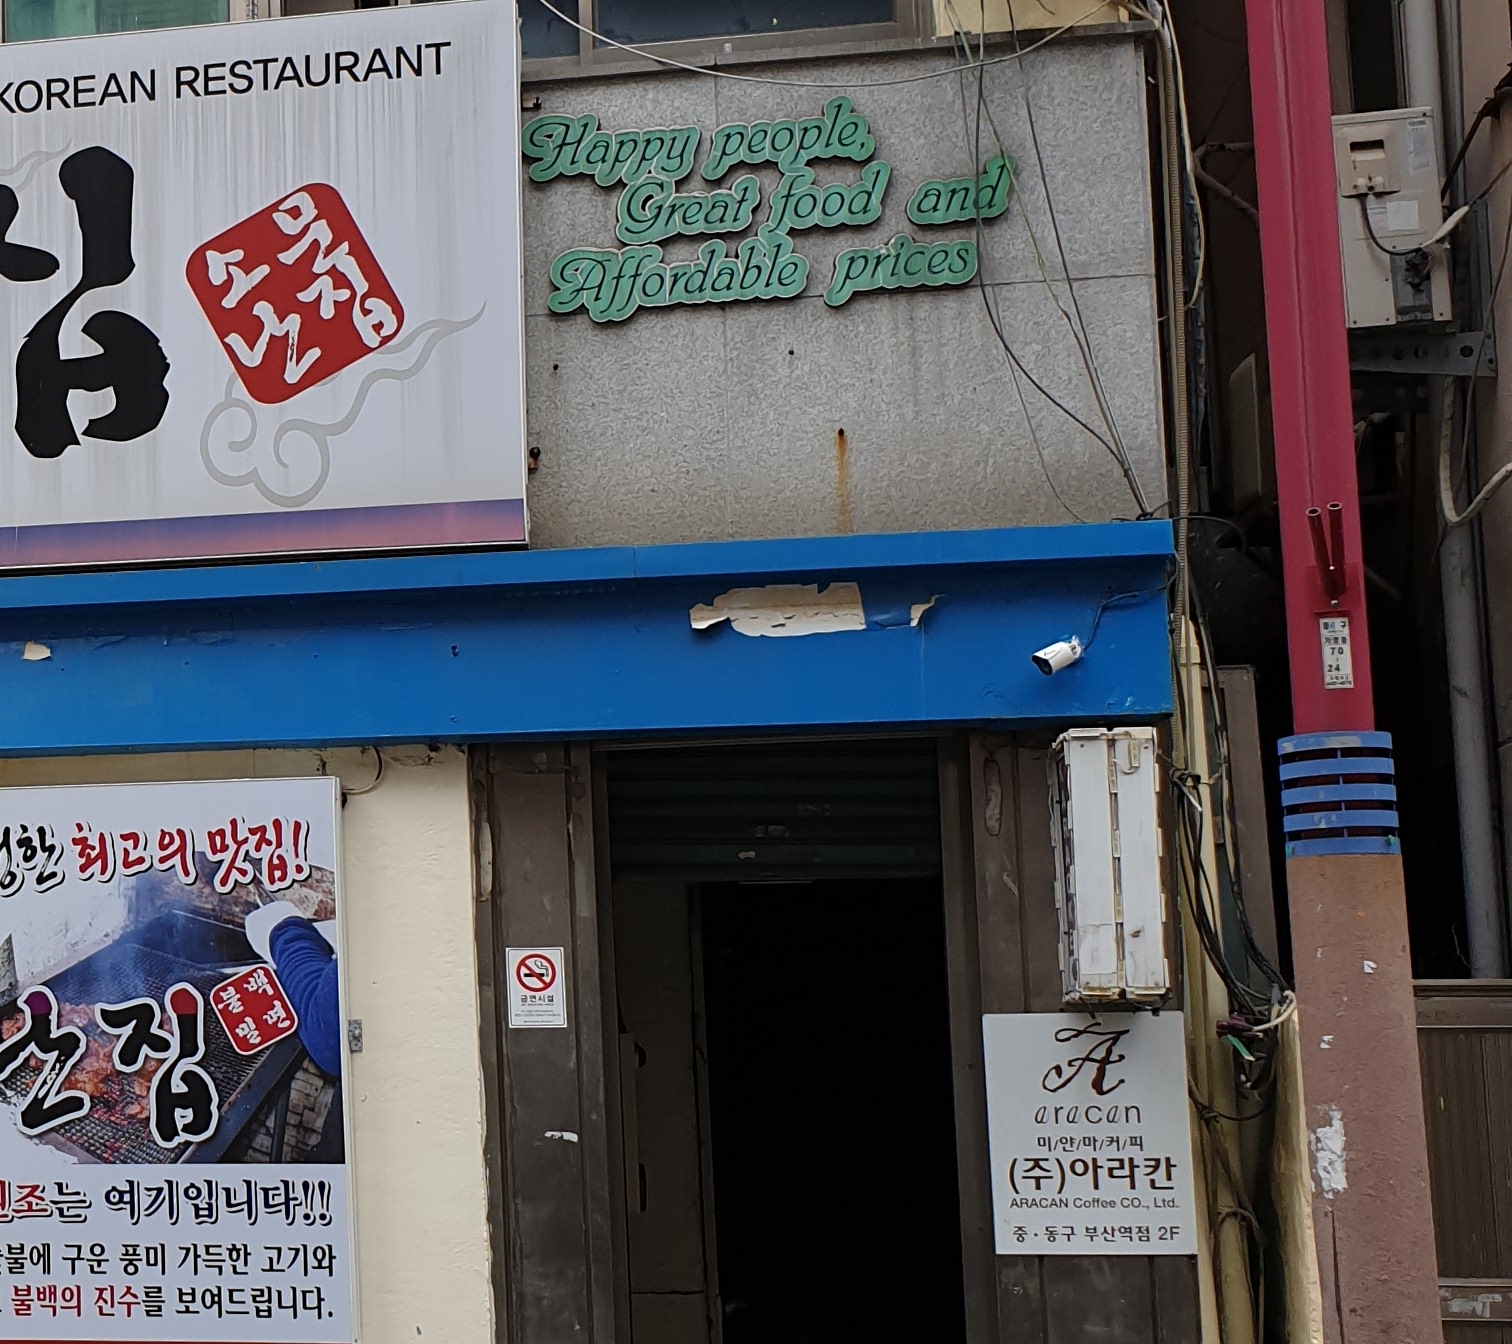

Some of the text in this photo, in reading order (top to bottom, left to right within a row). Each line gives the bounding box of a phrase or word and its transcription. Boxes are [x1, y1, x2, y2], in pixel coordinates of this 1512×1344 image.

[174, 41, 452, 99] RESTAURANT
[529, 101, 868, 178] Happy people,
[624, 158, 1007, 236] Great food and
[558, 234, 970, 315] Affordable prices
[74, 821, 201, 890] 최고의
[206, 815, 314, 894] 맛집!
[1034, 1105, 1142, 1124] aracan
[1008, 1157, 1177, 1194] (주)아라칸
[104, 1178, 333, 1225] 여기입니다!!
[1009, 1197, 1069, 1209] ARACAN
[1072, 1197, 1117, 1209] Coffee
[1153, 1197, 1180, 1209] Ltd.
[1084, 1225, 1151, 1243] 부산역점
[1157, 1226, 1181, 1242] 2F
[61, 1242, 111, 1275] 구운
[119, 1242, 167, 1275] 풍미
[177, 1242, 252, 1275] 가득한
[260, 1242, 337, 1275] 고기와
[11, 1285, 83, 1318] 불백의
[93, 1285, 166, 1318] 진수를
[176, 1285, 335, 1318] 보여드립니다.
